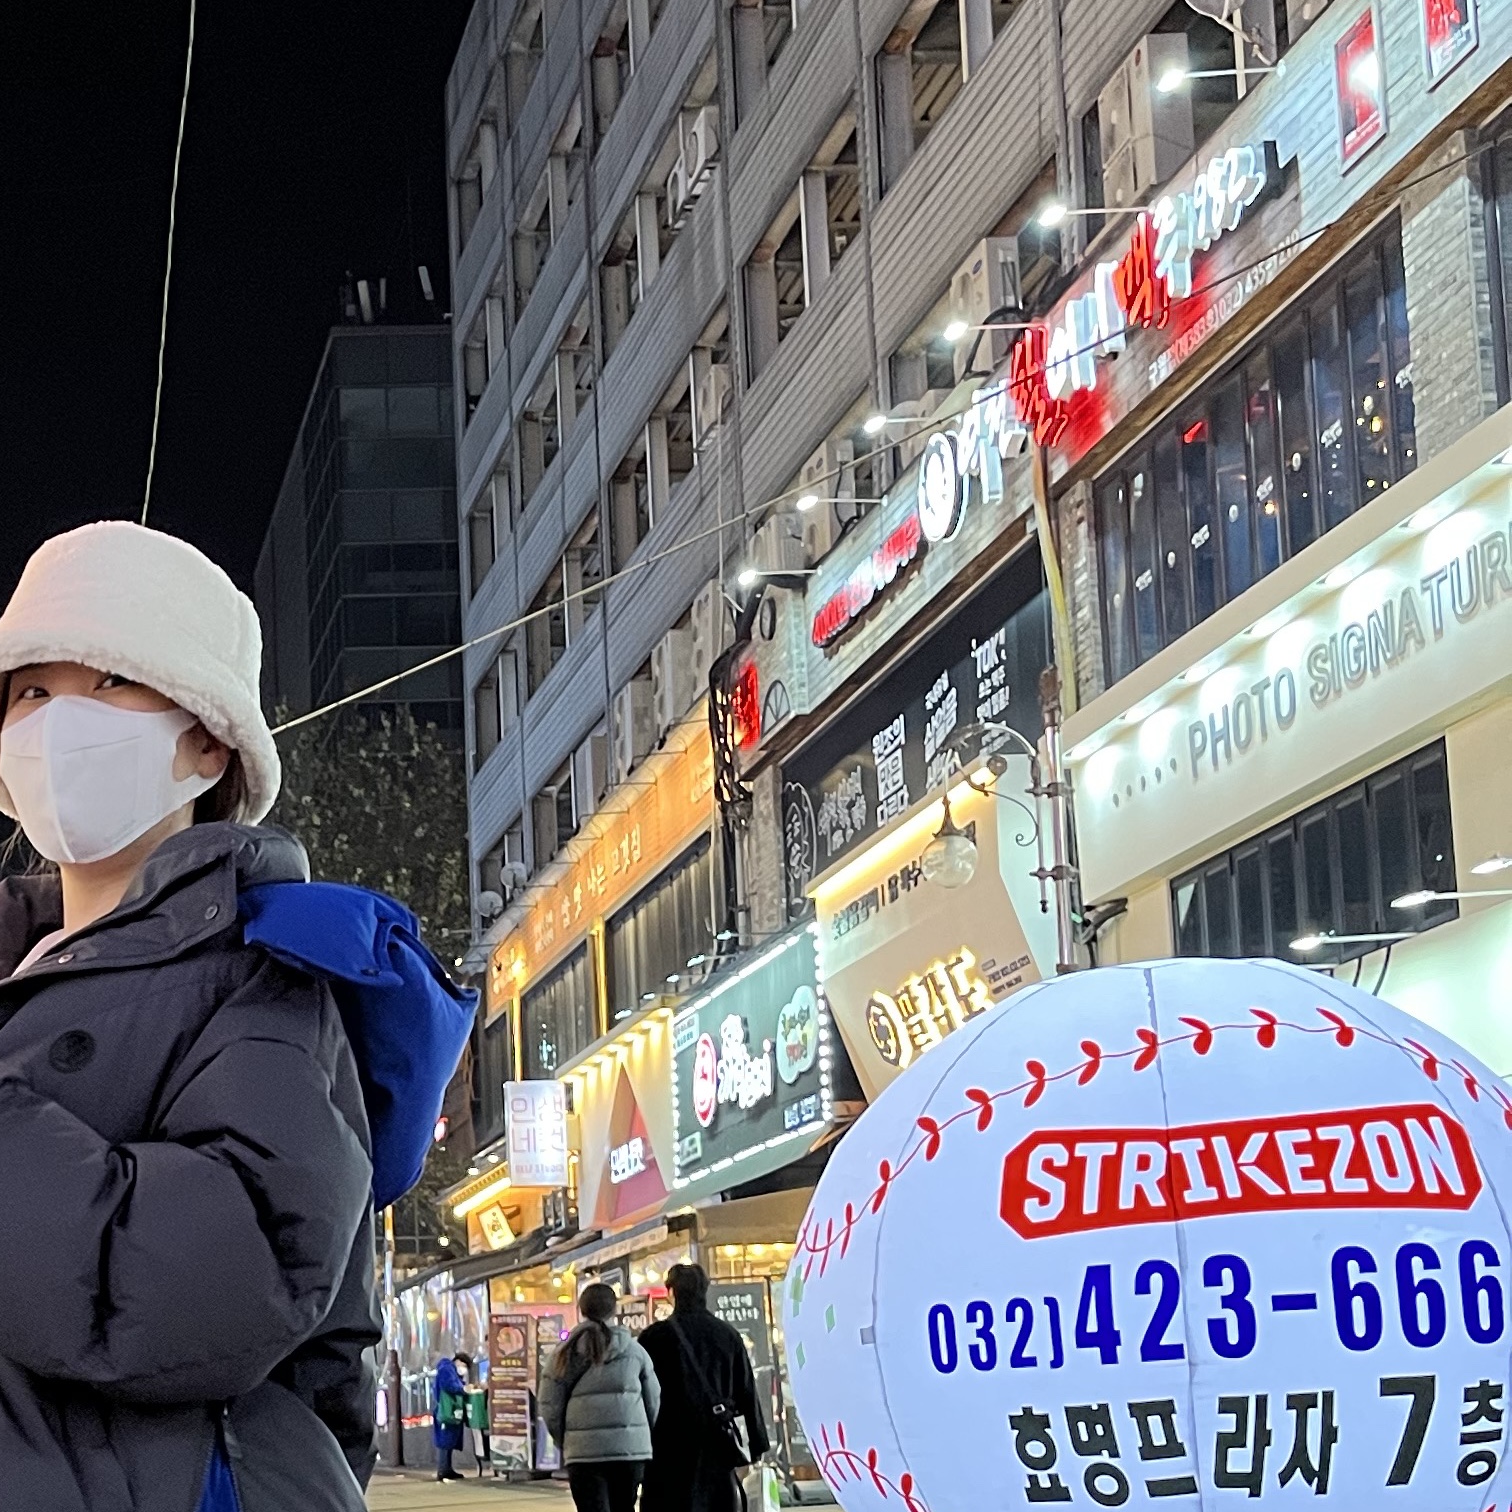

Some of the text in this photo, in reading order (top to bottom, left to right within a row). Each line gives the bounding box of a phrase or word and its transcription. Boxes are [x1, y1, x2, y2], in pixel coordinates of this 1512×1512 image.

[1187, 520, 1512, 780] PHOTO SIGNATUR
[1022, 1115, 1468, 1225] STRIKEZON
[1007, 1389, 1339, 1507] 효명프라자
